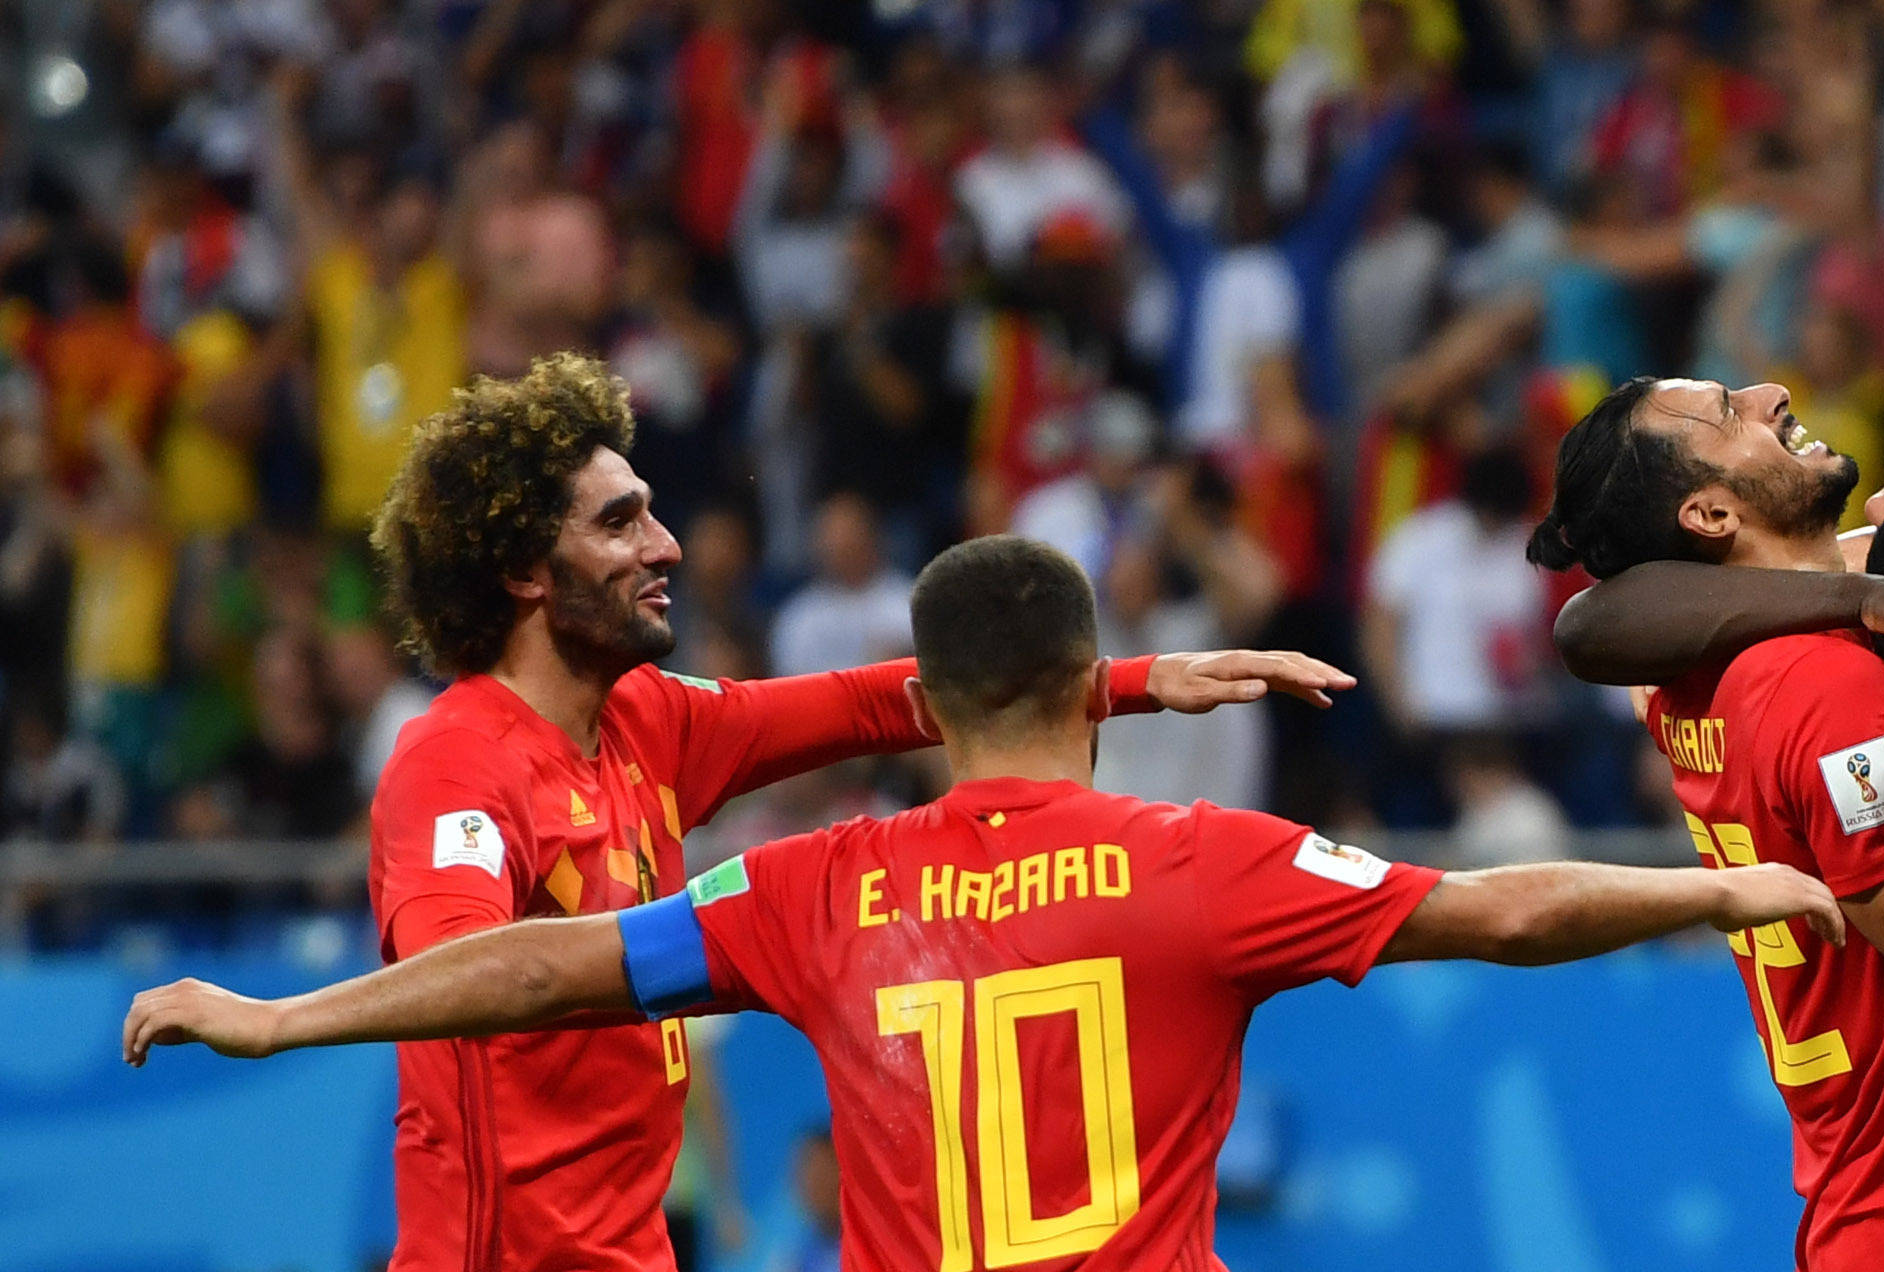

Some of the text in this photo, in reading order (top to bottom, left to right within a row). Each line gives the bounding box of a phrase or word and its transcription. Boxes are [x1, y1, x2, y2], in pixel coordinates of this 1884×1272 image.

[1846, 810, 1883, 827] RUSSIA
[859, 843, 1131, 928] E. HAZARD
